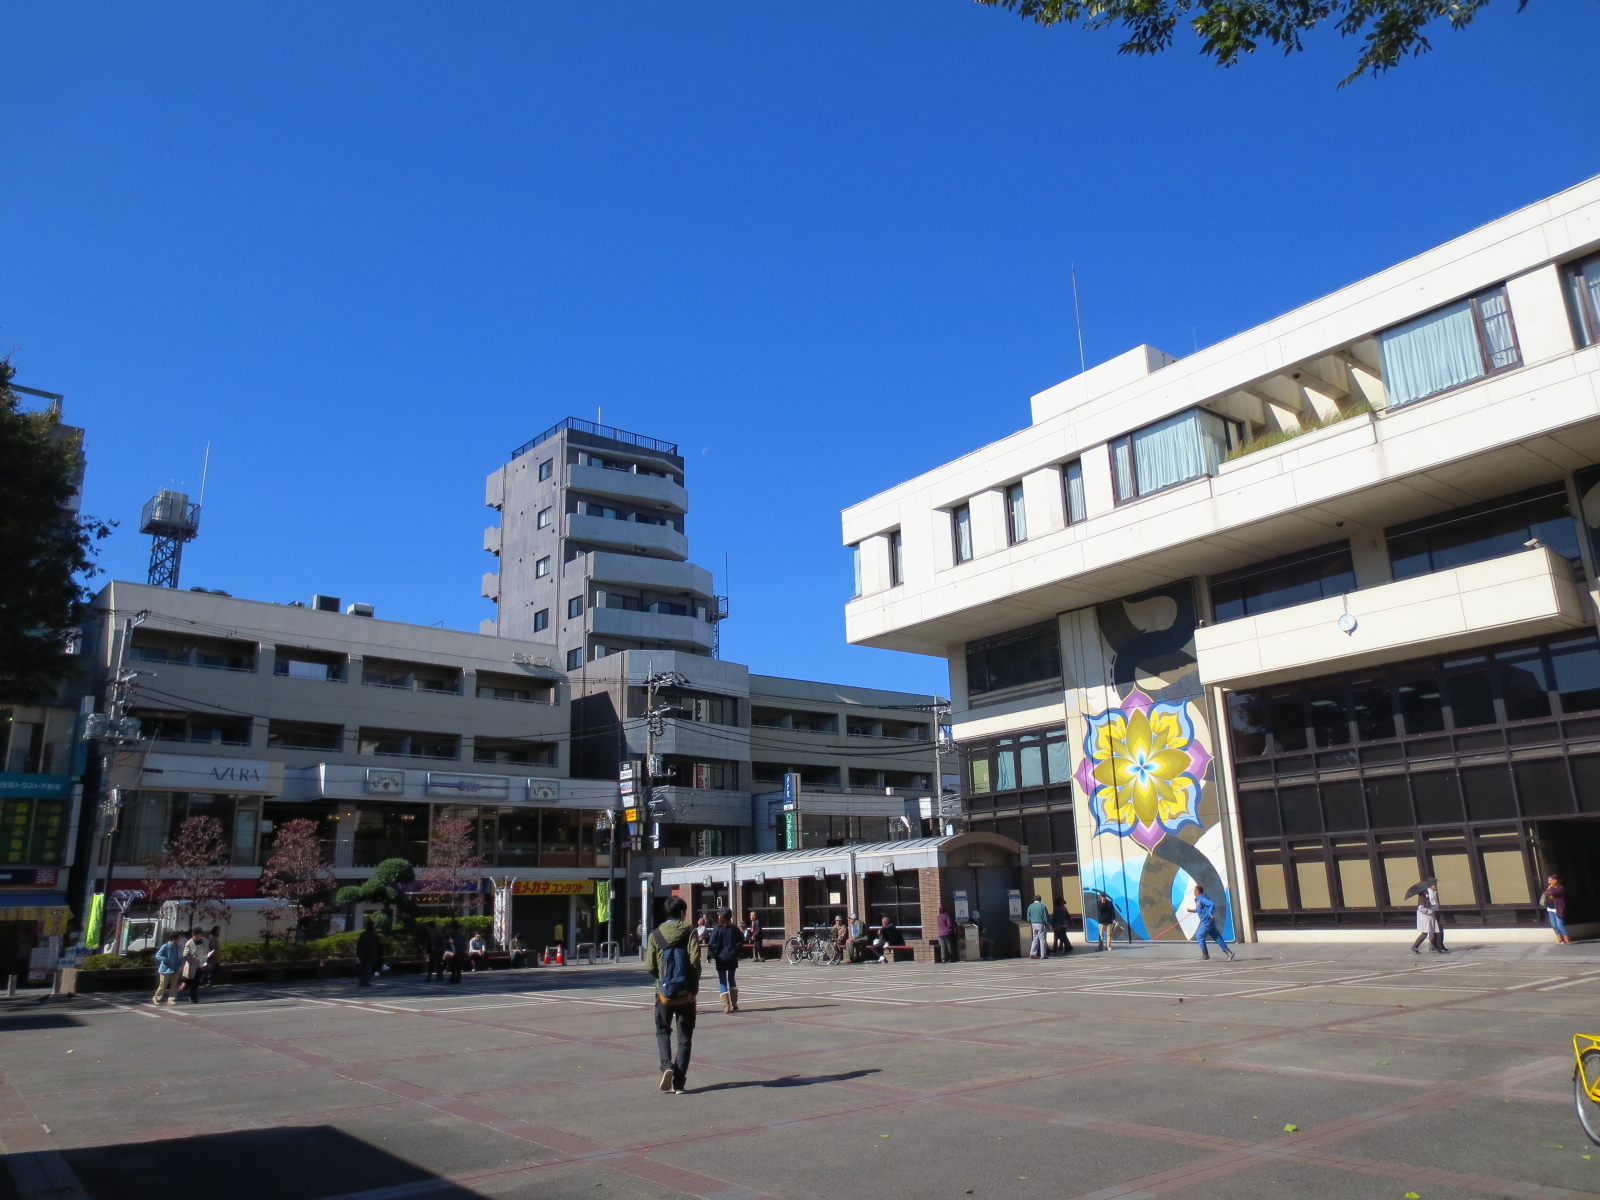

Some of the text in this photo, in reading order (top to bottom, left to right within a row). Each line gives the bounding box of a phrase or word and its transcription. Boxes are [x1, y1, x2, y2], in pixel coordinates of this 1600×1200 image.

[208, 766, 260, 782] AZURA
[621, 841, 631, 849] KFC
[36, 869, 54, 884] 薬
